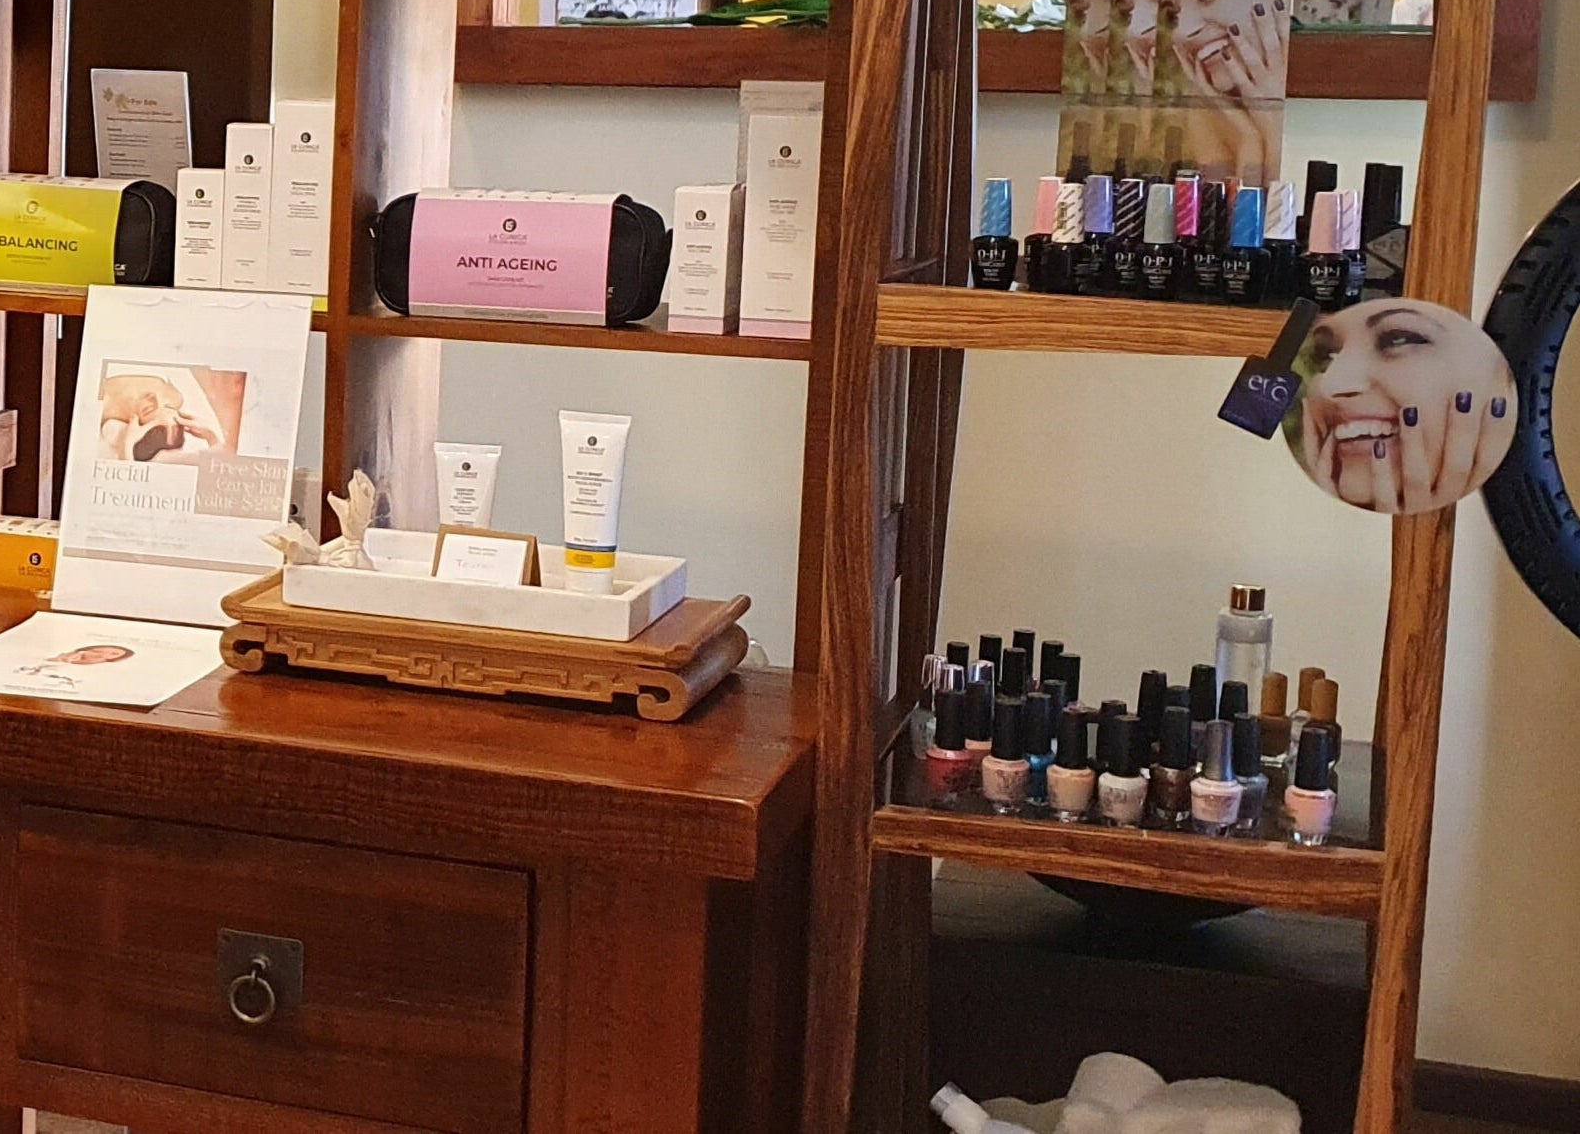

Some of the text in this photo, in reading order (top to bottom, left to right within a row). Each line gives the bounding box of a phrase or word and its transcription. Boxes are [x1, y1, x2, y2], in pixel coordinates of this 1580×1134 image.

[456, 255, 558, 272] ANTI AGEING
[92, 463, 150, 484] Facial
[209, 458, 288, 480] Free Skin
[92, 485, 193, 512] Treatment
[195, 493, 236, 509] Value
